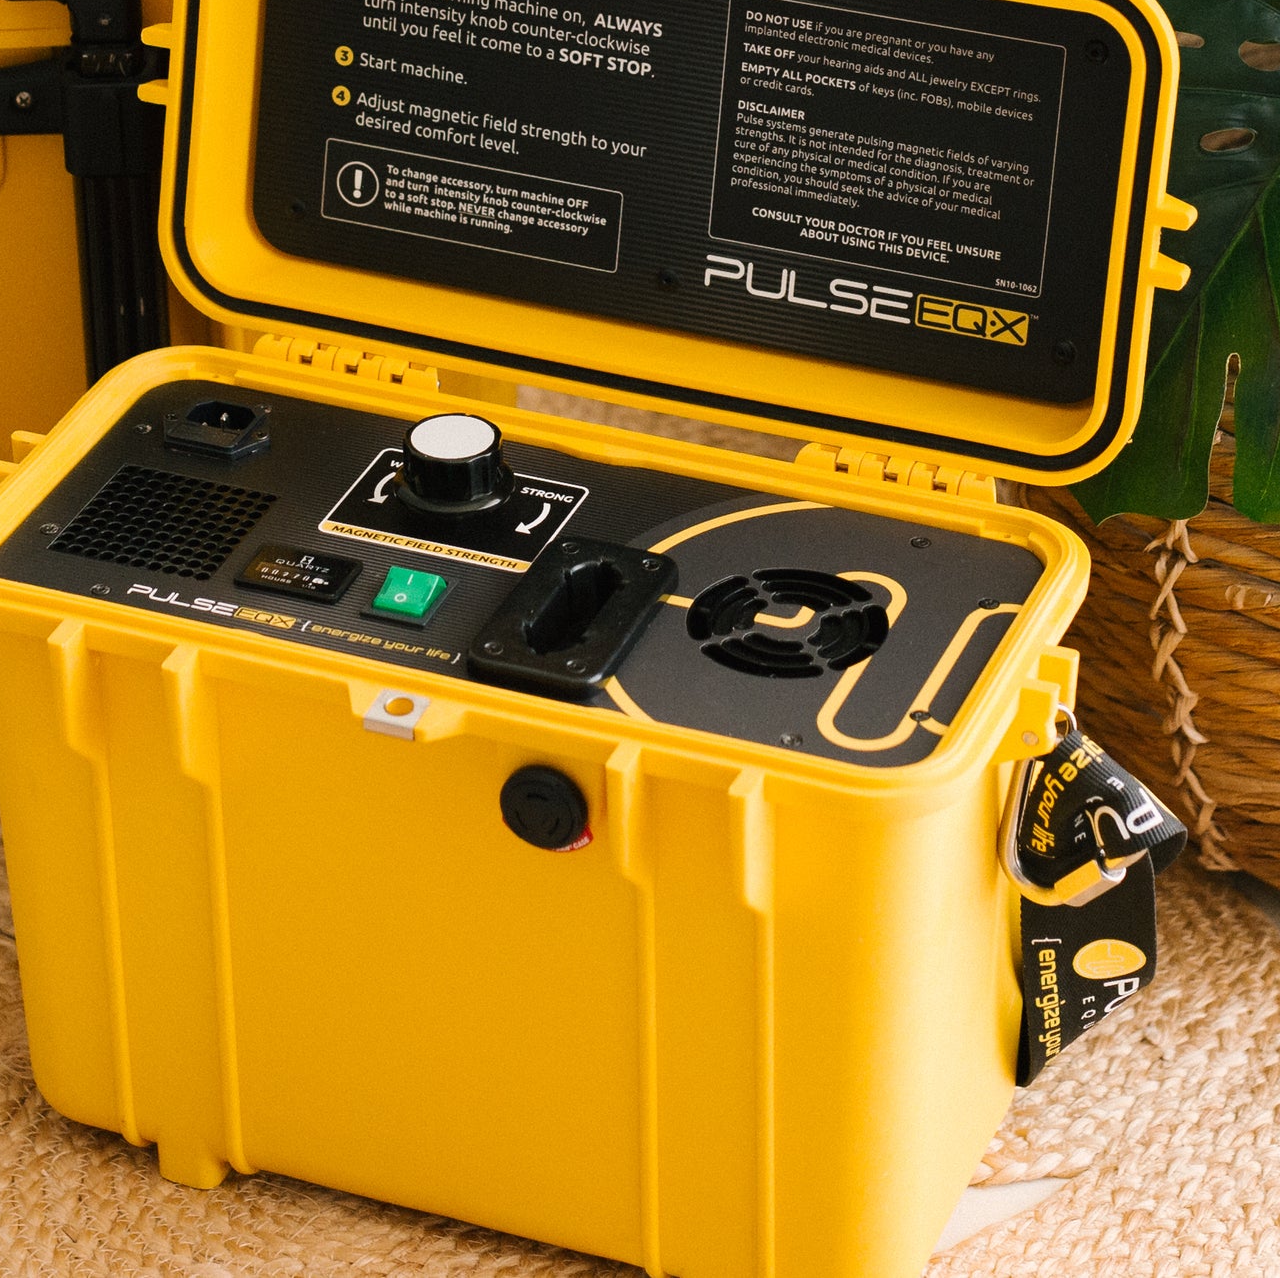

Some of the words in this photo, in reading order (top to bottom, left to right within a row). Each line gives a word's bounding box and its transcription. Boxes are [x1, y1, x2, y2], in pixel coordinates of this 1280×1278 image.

[400, 1, 466, 26] intensity
[469, 9, 507, 31] knob
[511, 21, 650, 56] counter-clockwise
[562, 10, 585, 26] on,
[593, 12, 662, 37] ALWAYS
[744, 22, 796, 40] implanted
[797, 31, 848, 50] electronic
[850, 42, 890, 57] medical
[892, 47, 934, 64] devices.
[745, 9, 763, 21] DO
[764, 13, 790, 26] NOT
[791, 17, 813, 30] USE
[814, 21, 823, 31] if
[824, 25, 843, 35] you
[845, 28, 862, 39] are
[864, 32, 912, 47] pregnant
[914, 40, 925, 48] or
[927, 43, 946, 53] you
[949, 43, 973, 57] have
[976, 50, 994, 62] any
[359, 51, 396, 72] Start
[400, 62, 467, 84] machine.
[362, 15, 396, 32] until
[399, 22, 428, 37] you
[432, 23, 461, 43] feel
[465, 32, 476, 46] it
[480, 36, 522, 54] come
[526, 42, 542, 57] to
[545, 48, 554, 60] a
[558, 47, 604, 68] SOFT
[606, 56, 654, 78] STOP.
[739, 76, 751, 84] or
[752, 78, 783, 90] credit
[784, 84, 814, 96] cards.
[741, 61, 780, 77] EMPTY
[781, 68, 802, 81] ALL
[805, 72, 856, 90] POCKETS
[858, 82, 870, 92] of
[872, 83, 894, 98] keys
[897, 88, 917, 100] (inc.
[920, 92, 953, 108] FOBs),
[956, 100, 992, 114] mobile
[994, 105, 1032, 121] devices
[742, 41, 771, 56] TAKE
[772, 47, 795, 59] OFF
[796, 53, 821, 64] your
[822, 55, 861, 73] hearing
[863, 64, 884, 75] aids
[886, 68, 906, 79] and
[907, 70, 927, 83] ALL
[928, 74, 968, 91] jewelry
[970, 80, 1011, 96] EXCEPT
[1012, 89, 1040, 102] rings.
[356, 91, 405, 113] Adjust
[408, 103, 479, 127] magnetic
[482, 112, 517, 134] field
[520, 122, 586, 146] strength
[591, 134, 607, 150] to
[610, 140, 647, 157] your
[737, 99, 805, 120] DISCLAIMER
[355, 110, 411, 134] desired
[414, 125, 476, 146] comfort
[479, 132, 519, 154] level.
[385, 177, 405, 188] and
[406, 180, 429, 192] turn
[434, 184, 480, 204] intensity
[482, 193, 508, 207] knob
[510, 200, 606, 226] counter-clockwise
[386, 163, 399, 175] To
[401, 166, 438, 183] change
[440, 175, 493, 194] accessory,
[495, 184, 518, 197] turn
[520, 190, 564, 206] machine
[566, 197, 588, 209] OFF
[383, 200, 412, 214] while
[413, 206, 457, 222] machine
[459, 212, 468, 224] is
[470, 217, 512, 234] running.
[384, 188, 396, 199] to
[398, 192, 404, 200] a
[406, 193, 428, 204] soft
[430, 197, 456, 211] stop.
[458, 201, 495, 219] NEVER
[496, 208, 534, 225] change
[536, 217, 588, 236] accessory
[751, 206, 802, 224] CONSULT
[804, 215, 835, 230] YOUR
[837, 221, 885, 239] DOCTOR
[887, 231, 898, 241] IF
[900, 233, 924, 246] YOU
[926, 238, 953, 252] FEEL
[955, 243, 1001, 260] UNSURE
[799, 227, 839, 242] ABOUT
[841, 234, 875, 250] USING
[877, 241, 903, 254] THIS
[905, 246, 949, 263] DEVICE.
[994, 277, 1037, 293] SN10-1062
[520, 487, 574, 502] STRONG
[275, 558, 330, 574] QUARTZ
[332, 526, 403, 545] MAGNETIC
[406, 539, 443, 554] FIELD
[444, 549, 518, 568] STRENGTH
[261, 574, 292, 584] HOURS
[311, 624, 382, 646] energize
[383, 640, 426, 654] your
[426, 648, 451, 660] life
[1038, 773, 1064, 828] your
[1031, 823, 1055, 853] life
[1035, 948, 1066, 1029] energize
